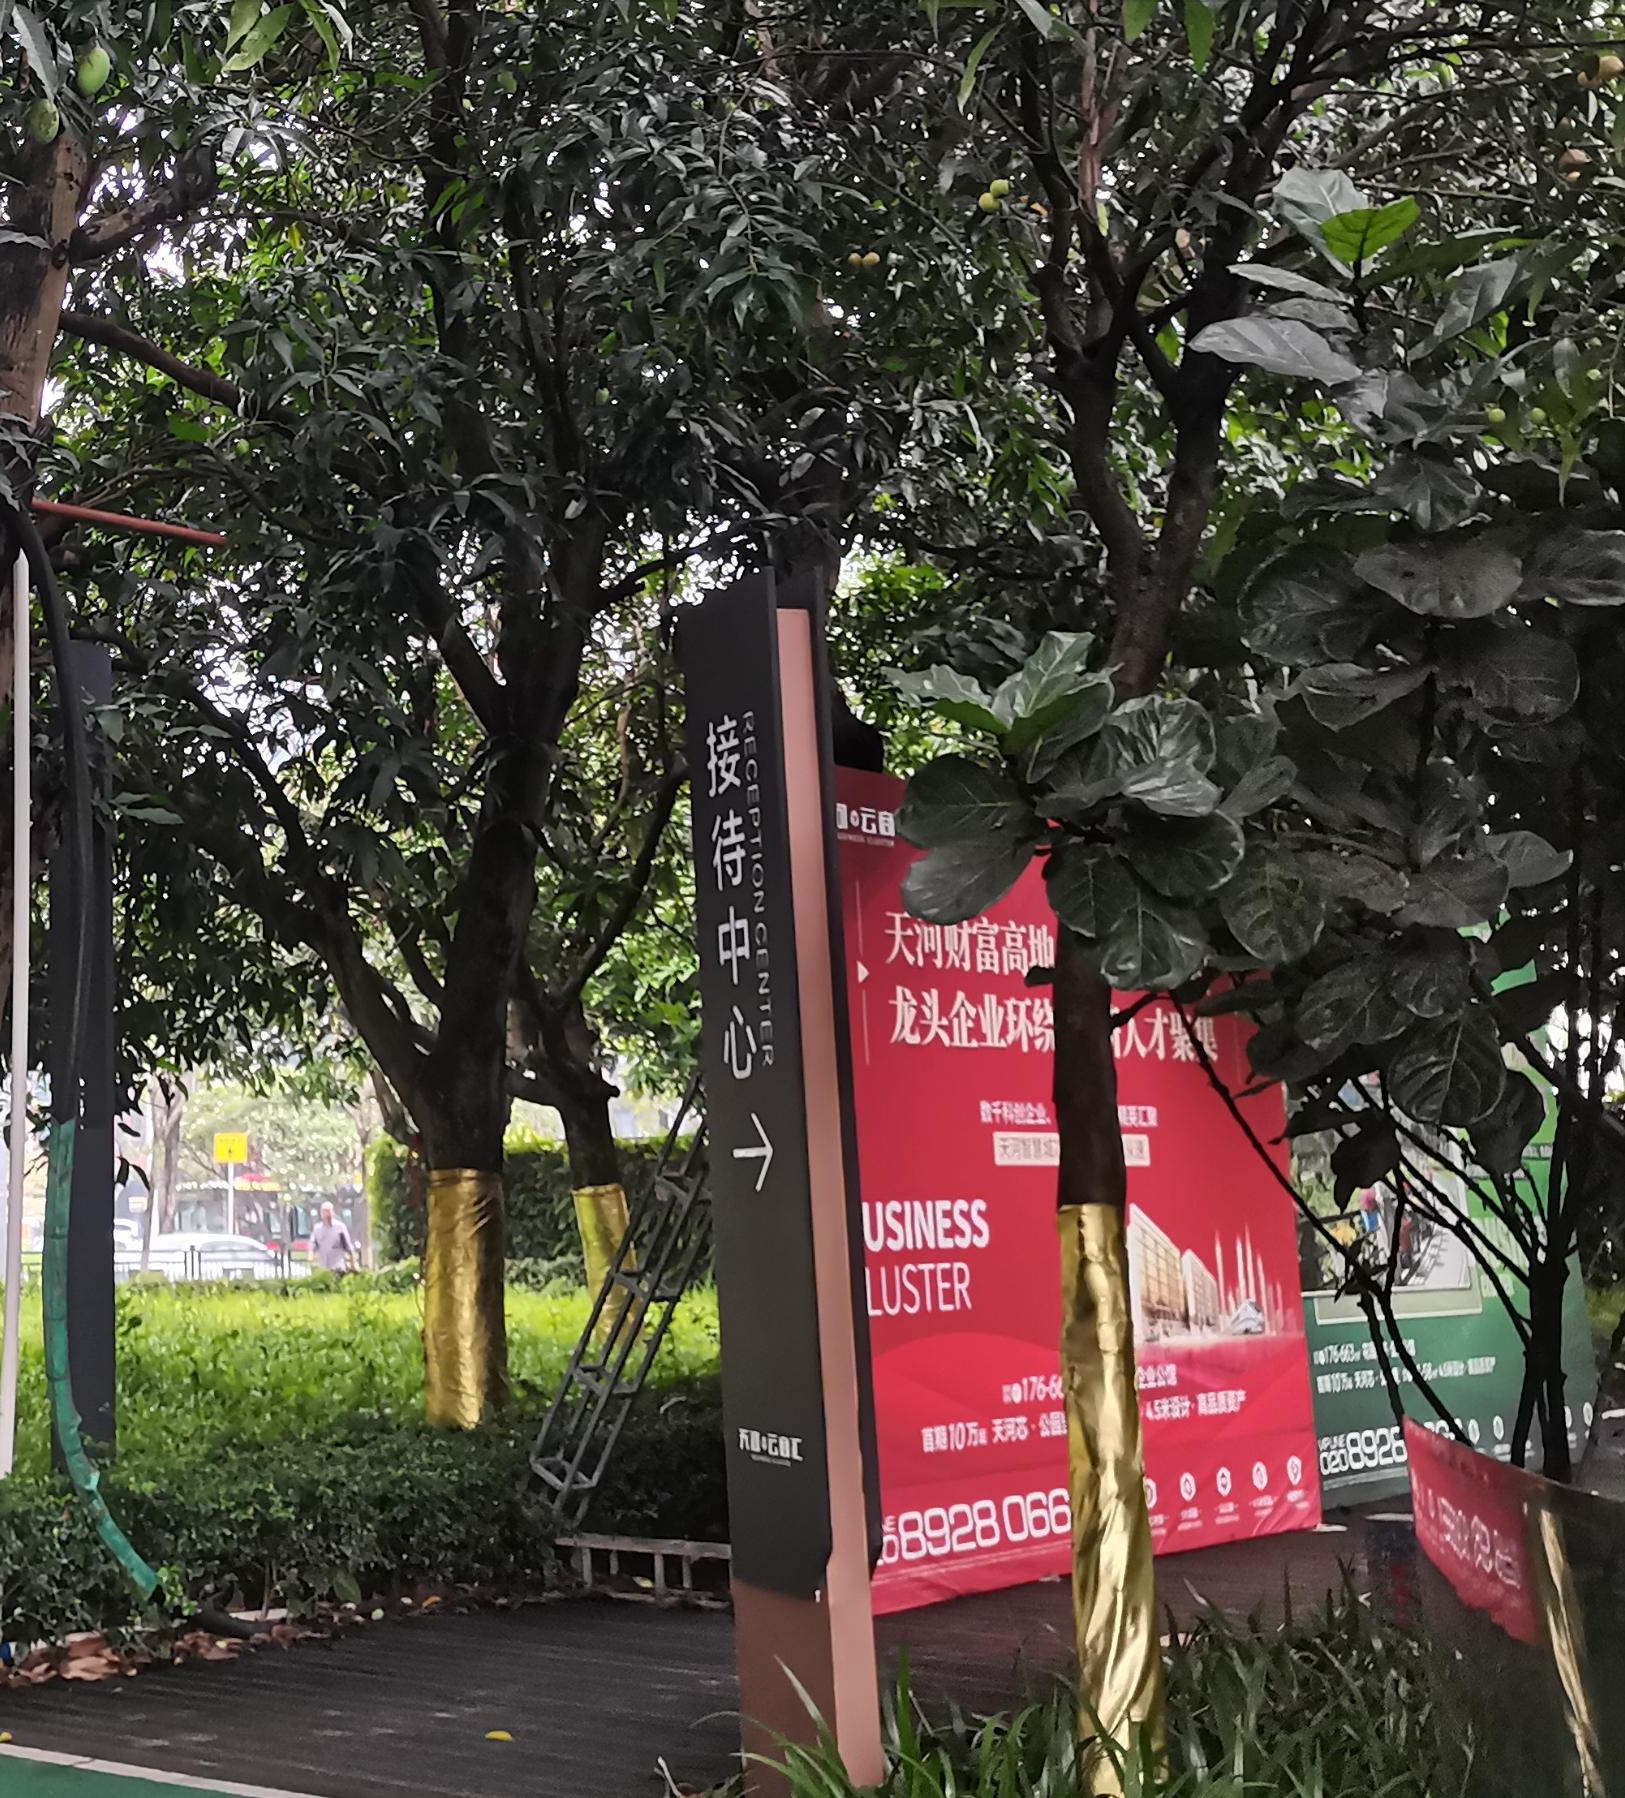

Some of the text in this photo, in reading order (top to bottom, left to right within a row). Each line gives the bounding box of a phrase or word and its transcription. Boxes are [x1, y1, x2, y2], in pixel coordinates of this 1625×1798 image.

[706, 714, 758, 1080] 接待中心
[742, 711, 774, 1067] RECEPTION CENTER
[898, 1511, 1001, 1560] 8928
